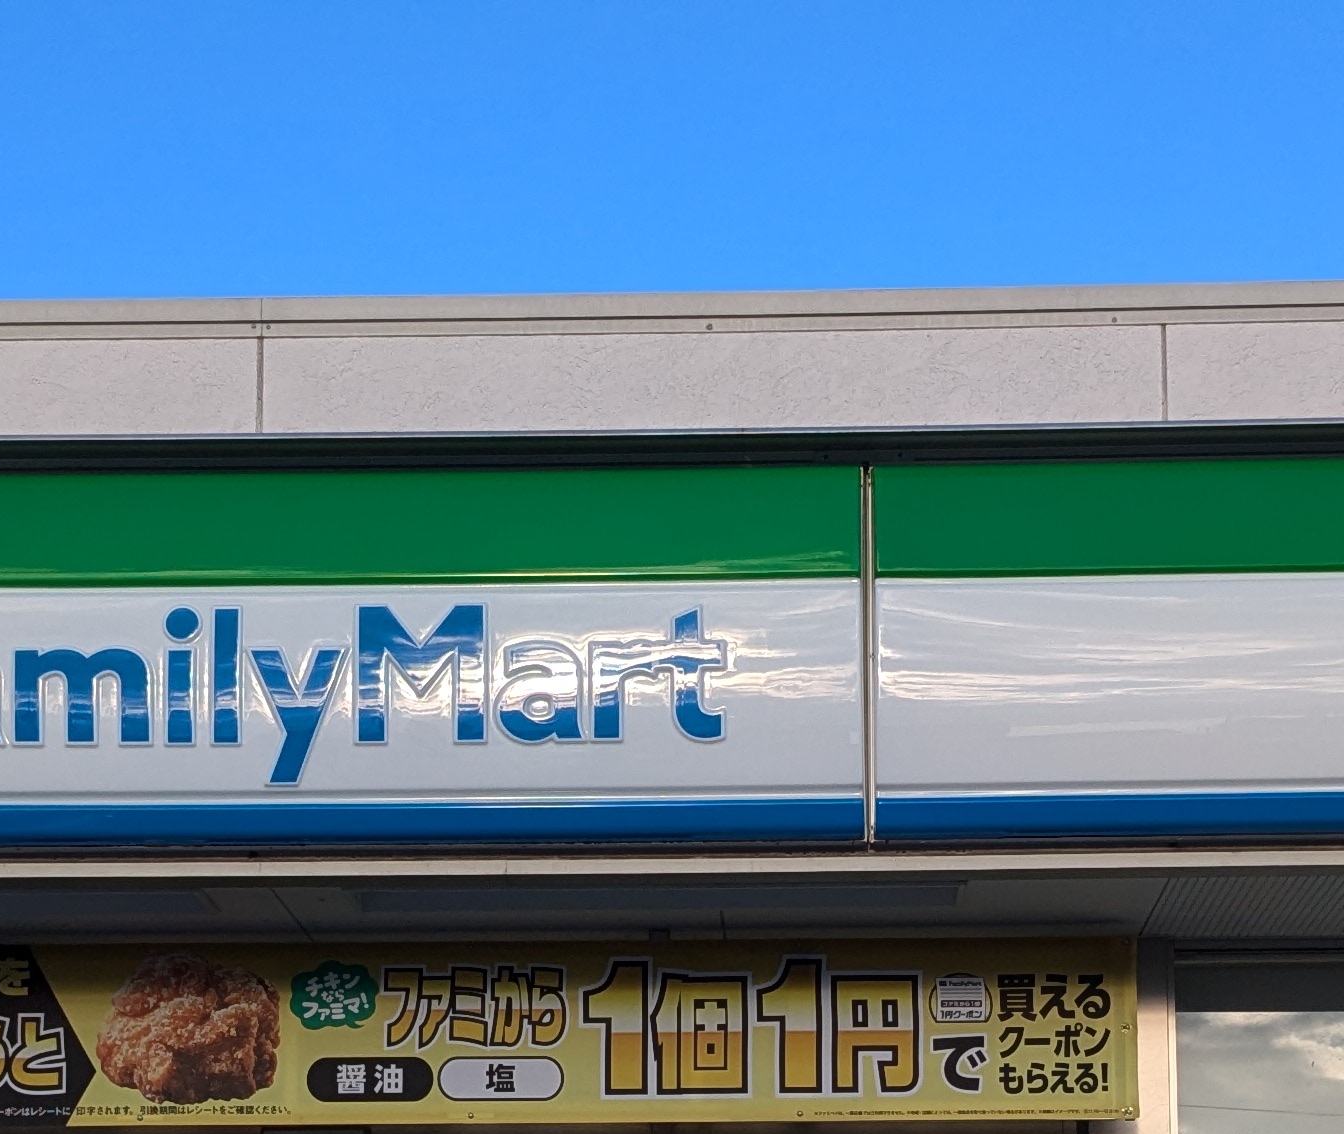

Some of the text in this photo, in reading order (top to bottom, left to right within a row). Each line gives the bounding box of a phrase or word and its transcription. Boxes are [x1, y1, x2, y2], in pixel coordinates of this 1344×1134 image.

[306, 972, 360, 997] チキン
[321, 989, 343, 1003] なら
[997, 974, 1111, 1022] 買える
[302, 992, 369, 1021] ファミマ!
[382, 964, 568, 1051] ファミから
[998, 1022, 1111, 1059] クーポン
[486, 1064, 516, 1092] 塩
[931, 1033, 989, 1093] で
[998, 1062, 1109, 1094] もらえる!
[336, 1064, 404, 1094] 醤油
